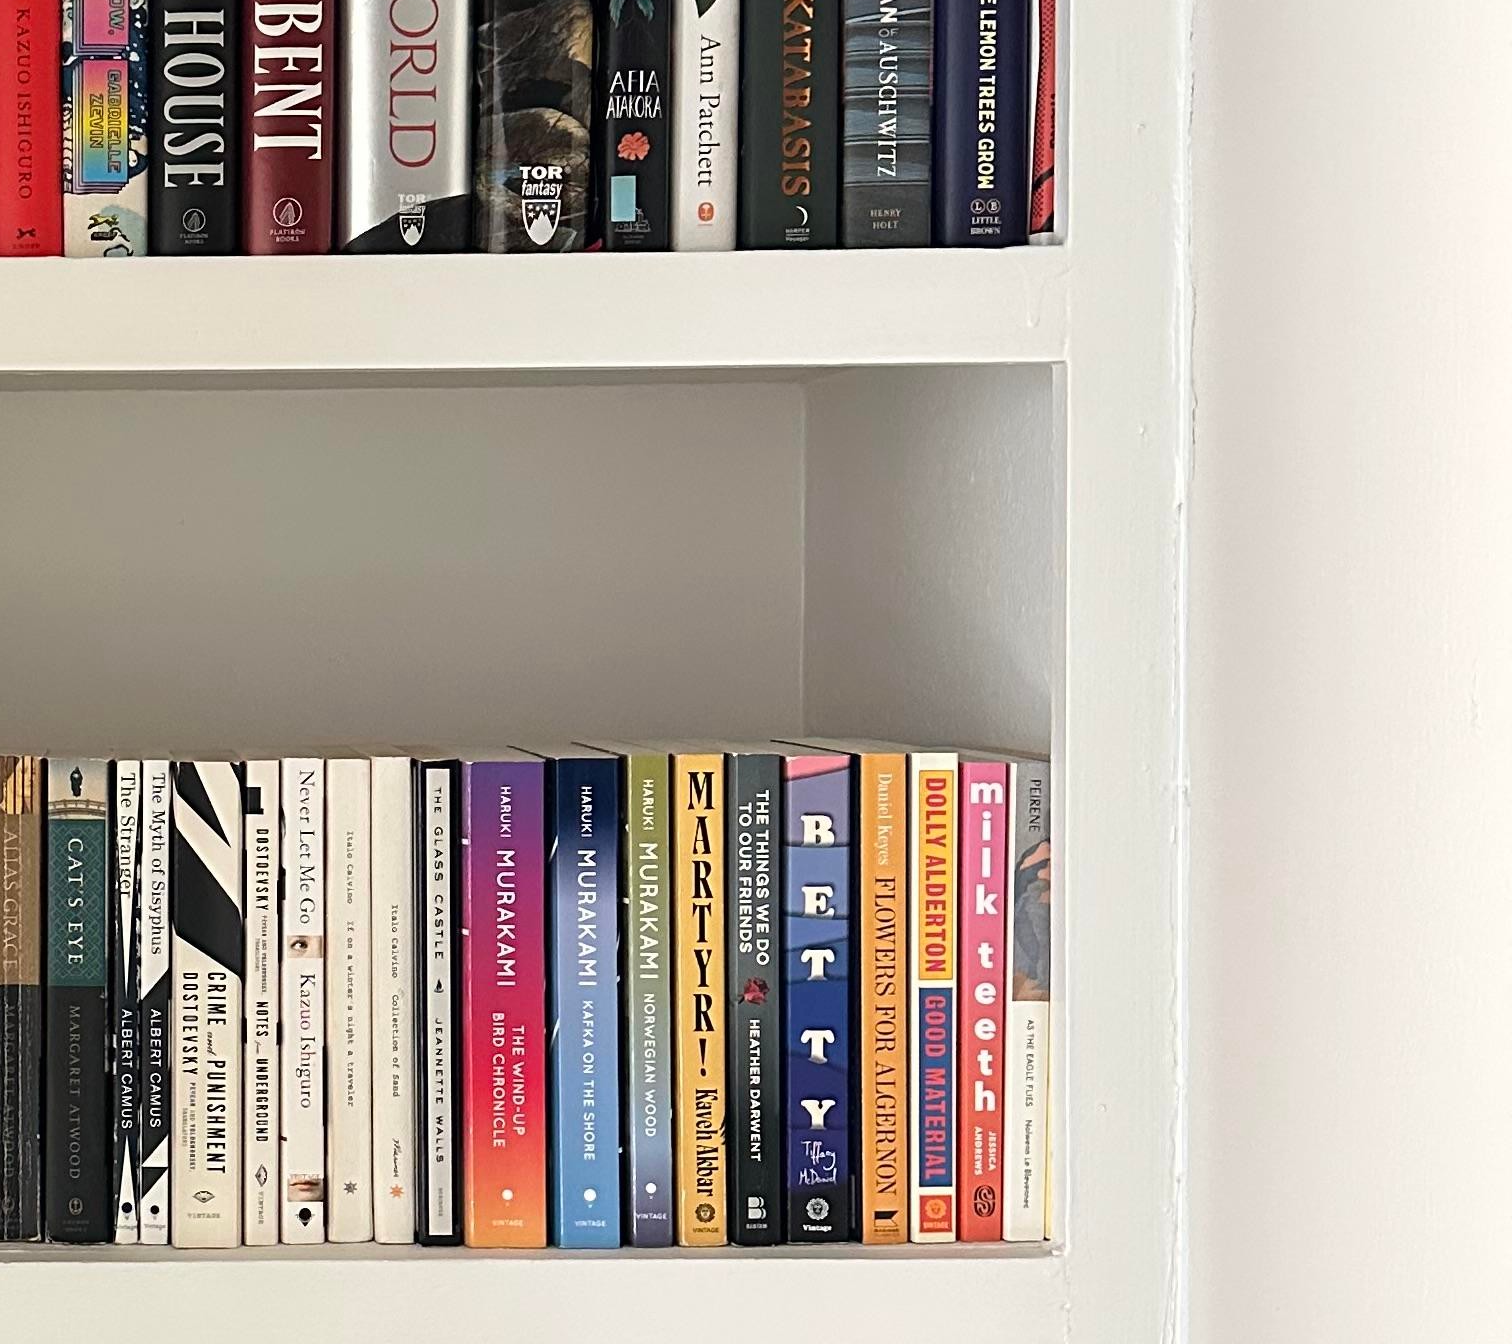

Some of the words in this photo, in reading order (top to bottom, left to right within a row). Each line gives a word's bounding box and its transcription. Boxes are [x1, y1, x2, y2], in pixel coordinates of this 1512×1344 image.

[254, 1, 322, 160] BENT
[610, 70, 660, 94] AFIA
[701, 32, 720, 85] Ann
[164, 10, 225, 189] HOUSE
[606, 95, 662, 120] ATAKORA
[699, 92, 720, 187] Patchett
[520, 166, 563, 181] TOR
[521, 180, 563, 199] fantasy
[873, 220, 898, 229] HOLT
[121, 773, 137, 808] The
[152, 775, 165, 801] The
[500, 786, 512, 838] HARUKI
[643, 779, 654, 831] HARUKI
[925, 777, 947, 846] DOLLY
[120, 817, 137, 896] Stranger
[152, 806, 165, 847] Myth
[970, 780, 1003, 915] milk
[152, 853, 162, 866] of
[152, 871, 164, 955] Sisyphus
[496, 850, 515, 988] MURAKAMI
[639, 843, 659, 979] MURAKAMI
[687, 771, 715, 1077] MARTYR!
[874, 876, 896, 996] FLOWERS
[925, 856, 947, 973] ALDERTON
[208, 973, 226, 1025] CRIME
[300, 974, 316, 1030] Kazuo
[800, 815, 836, 1130] BETTY
[122, 1009, 133, 1067] ALBERT
[182, 973, 198, 1076] DOSTOEVSKY
[207, 1033, 215, 1057] and
[644, 993, 656, 1084] NORWEGIAN
[874, 1006, 896, 1054] FOR
[923, 995, 946, 1055] GOOD
[974, 942, 996, 1112] teeth
[122, 1073, 132, 1129] CAMUS
[296, 1037, 316, 1109] Ishiguro
[207, 1060, 226, 1175] PUNISHMENT
[644, 1089, 656, 1137] WOOD
[874, 1062, 897, 1195] ALGERNON
[924, 1066, 946, 1177] MATERIAL
